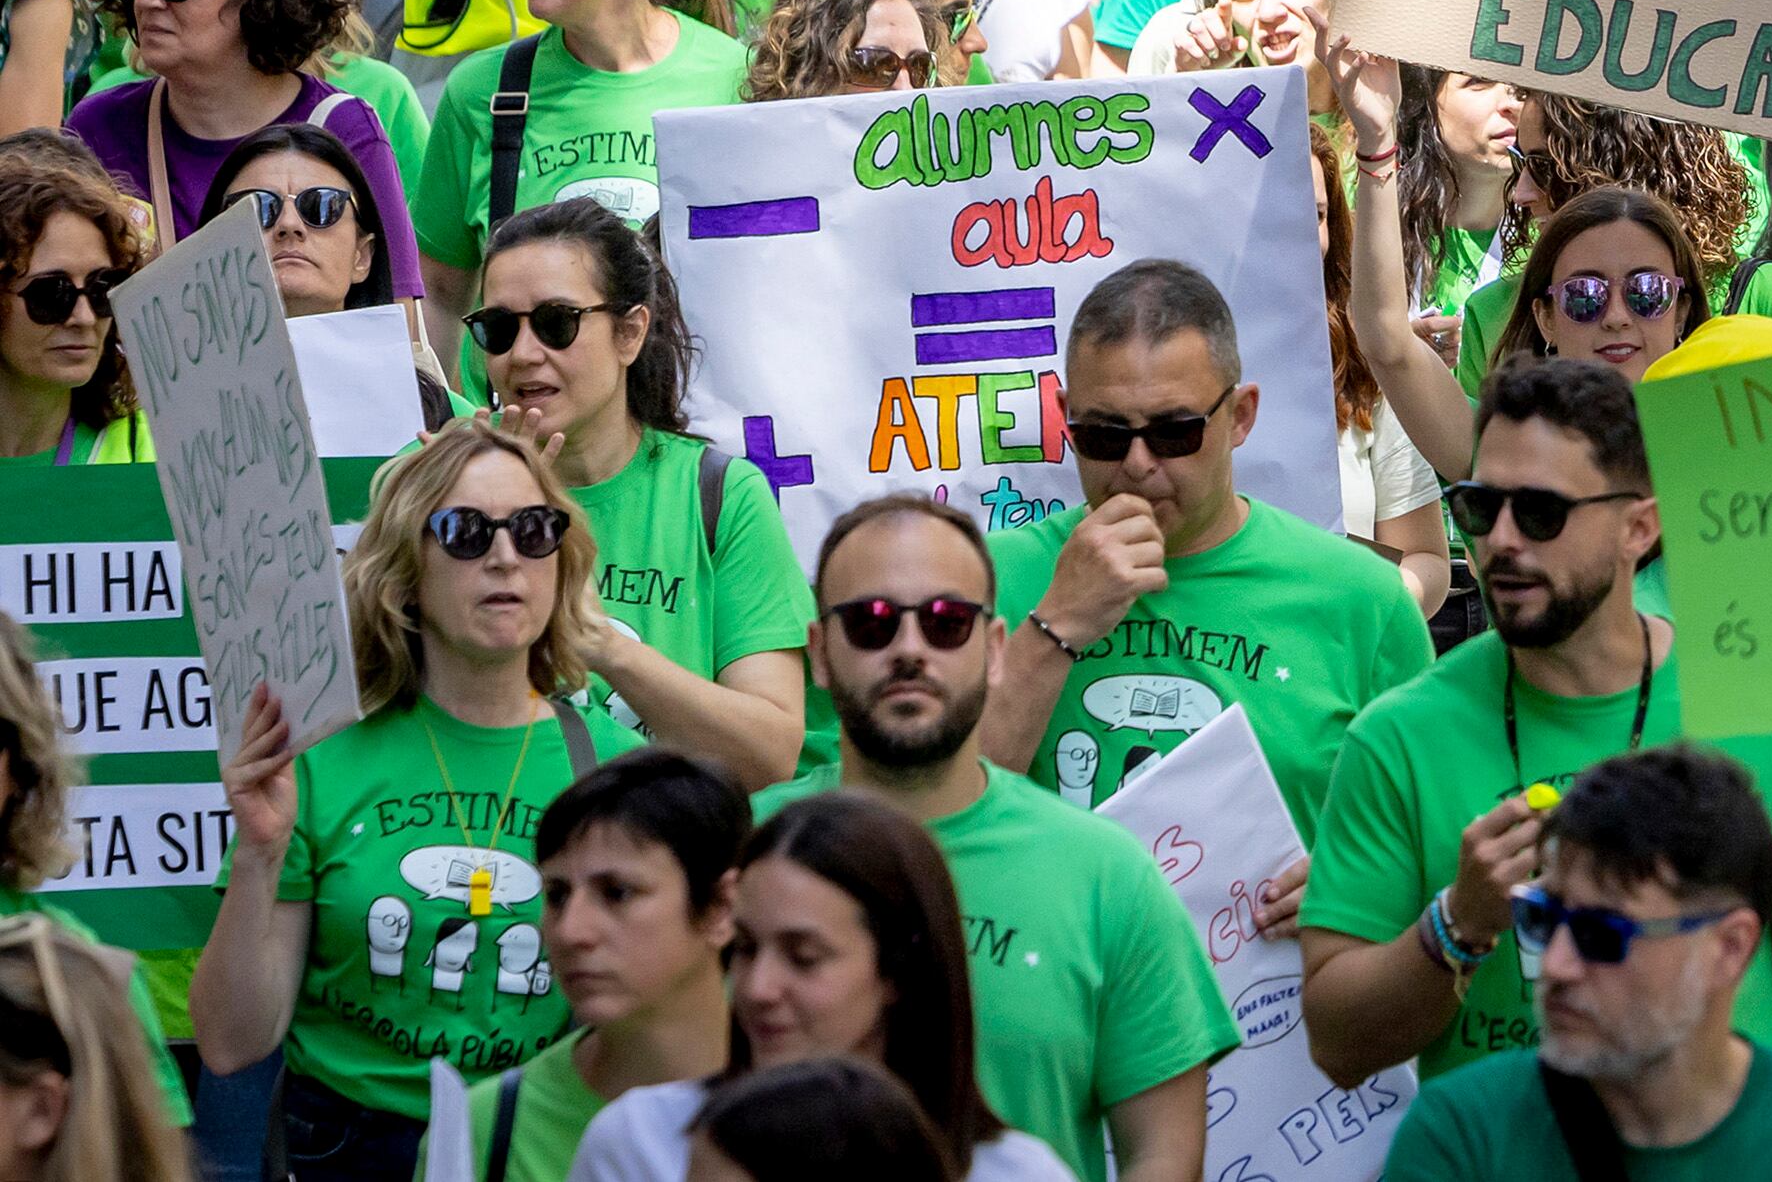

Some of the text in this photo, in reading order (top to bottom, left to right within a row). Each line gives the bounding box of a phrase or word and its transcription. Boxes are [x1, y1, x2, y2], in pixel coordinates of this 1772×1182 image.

[532, 131, 657, 179] ESTIM
[853, 93, 1155, 190] alumnes
[952, 175, 1114, 269] aula
[131, 295, 179, 417] NO
[23, 549, 176, 615] HI HA
[1712, 598, 1759, 660] és
